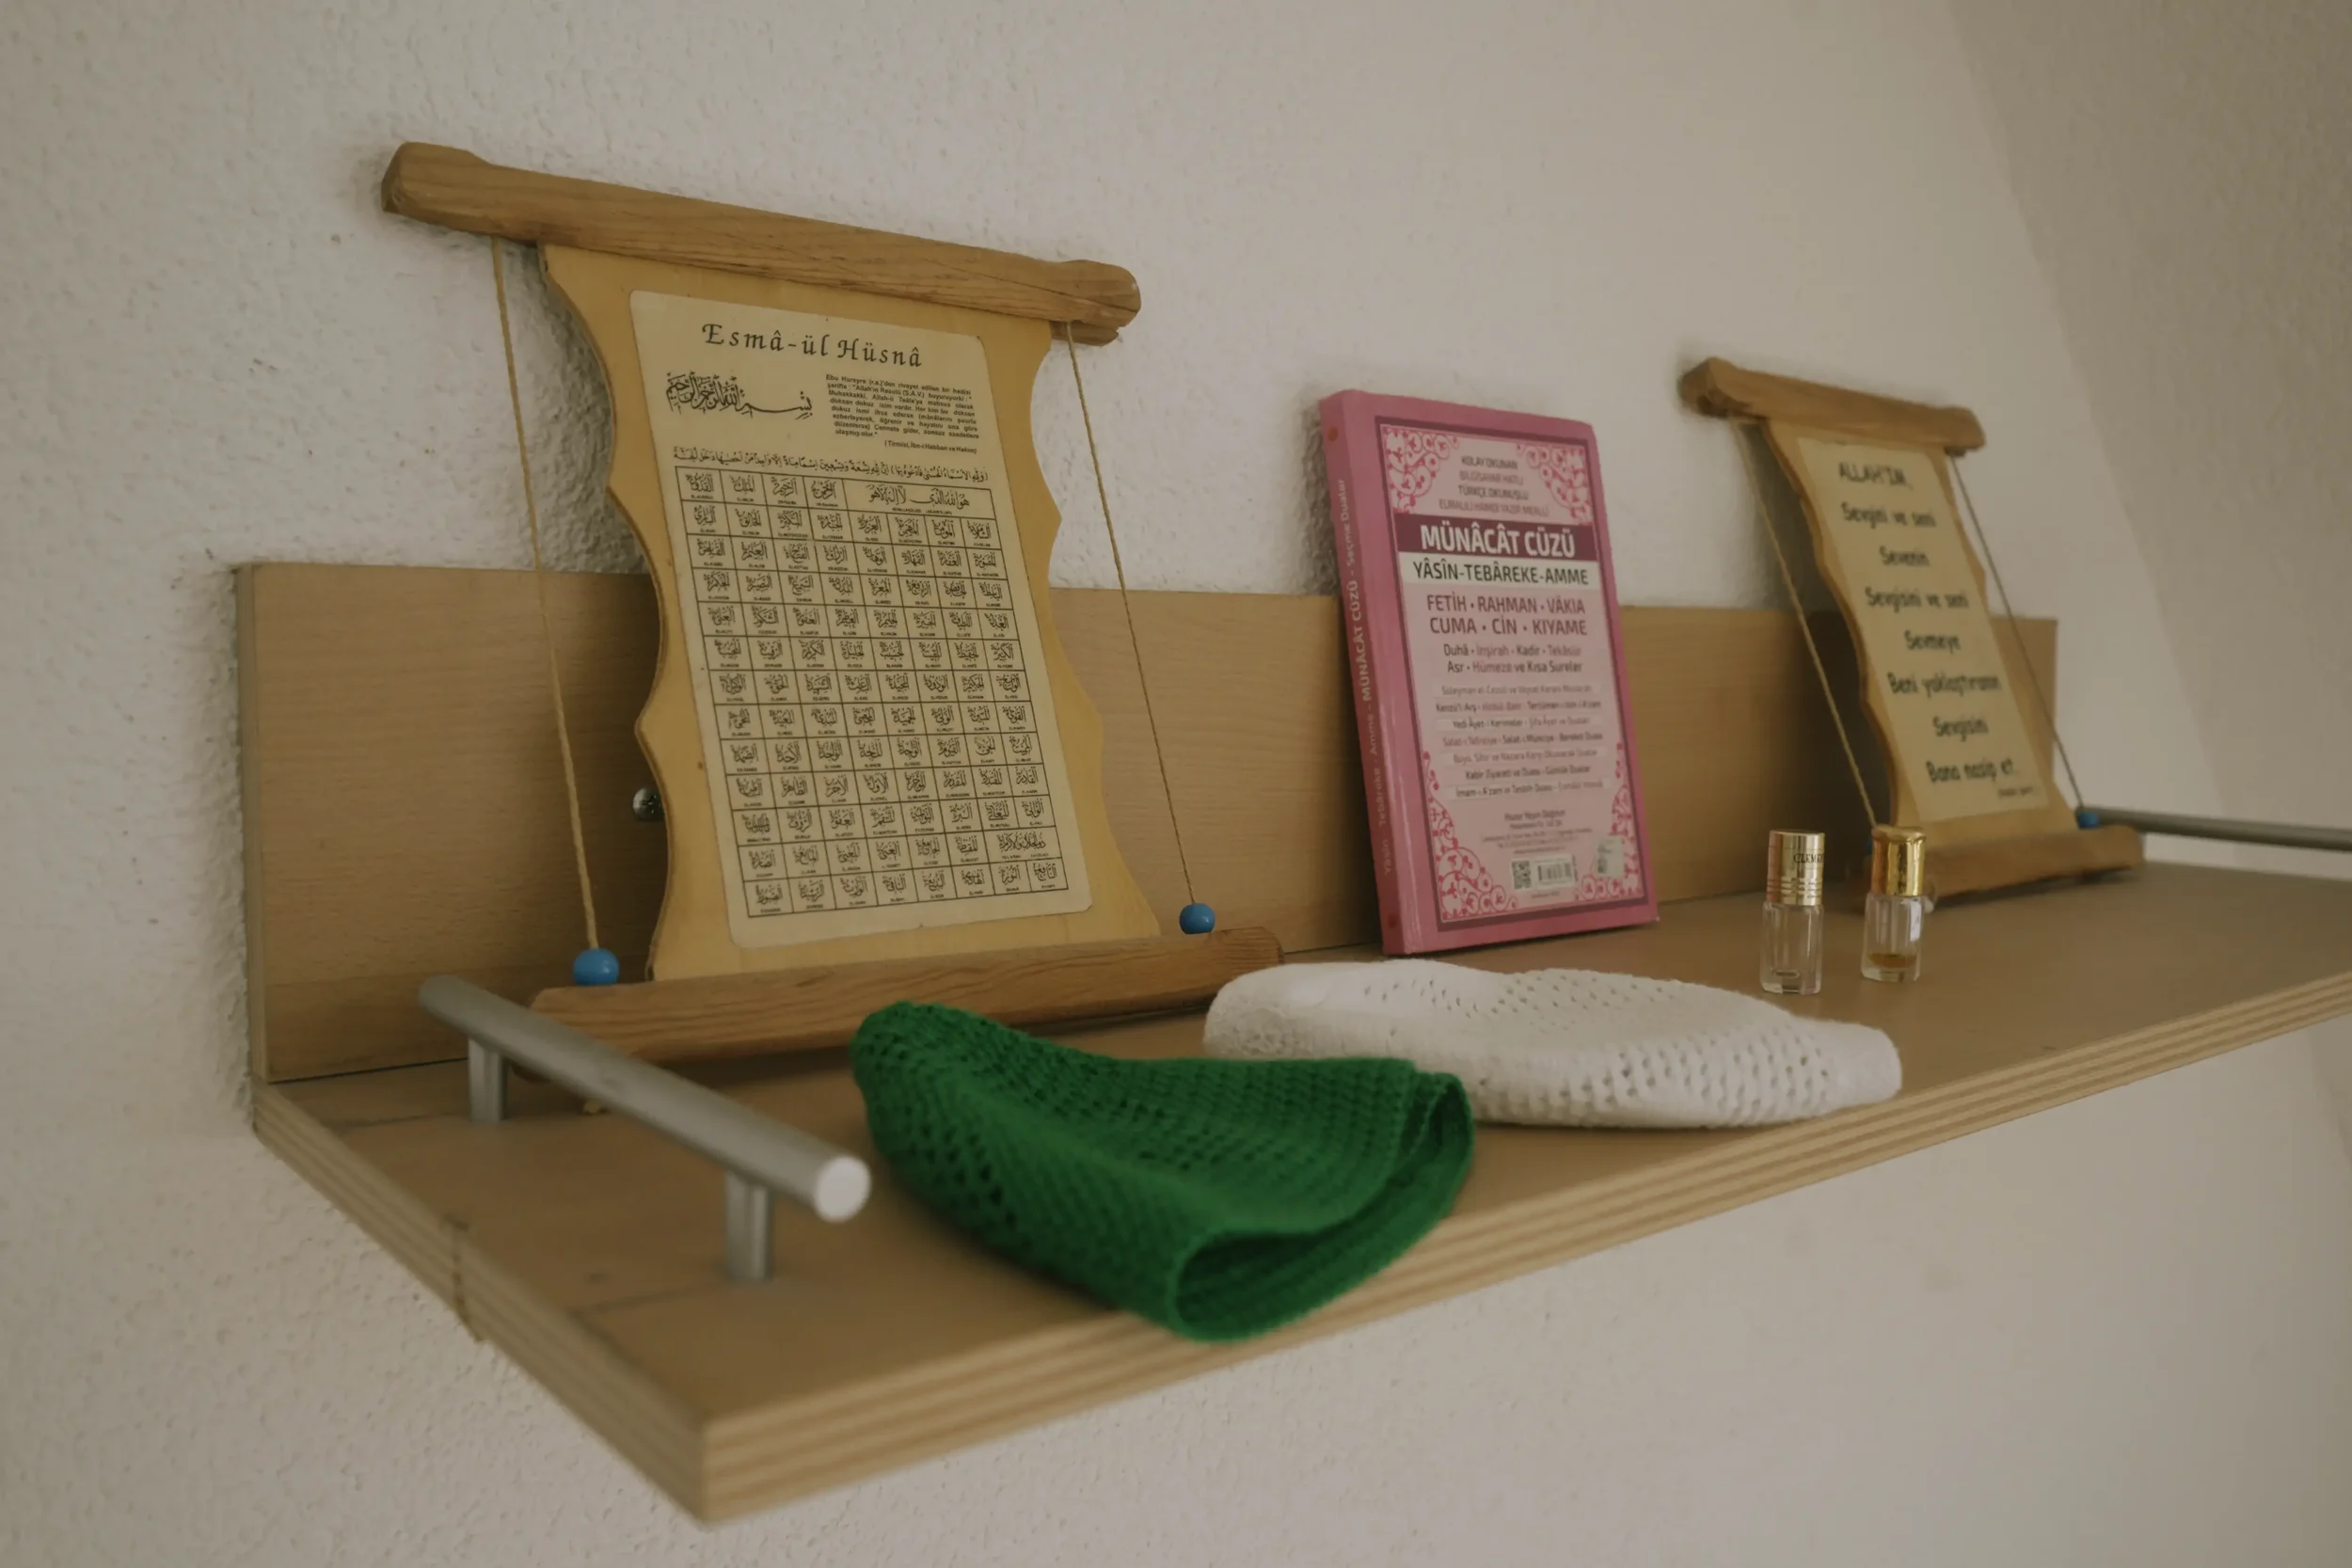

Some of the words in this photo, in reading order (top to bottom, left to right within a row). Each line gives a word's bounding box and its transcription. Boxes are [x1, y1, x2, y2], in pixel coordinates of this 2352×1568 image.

[702, 324, 829, 356] Esmâ-ül
[837, 339, 921, 367] Hüsnâ
[1421, 521, 1519, 554] MÜNÂCÂT
[1524, 527, 1575, 558] CÜZÜ
[1426, 592, 1467, 612] FETİH
[1477, 595, 1537, 613] RAHMAN
[1429, 617, 1477, 634] CUMA
[1491, 615, 1518, 635] CİN
[1533, 619, 1587, 636] KIYAME
[1447, 660, 1464, 673] Asr
[1514, 663, 1526, 673] ve
